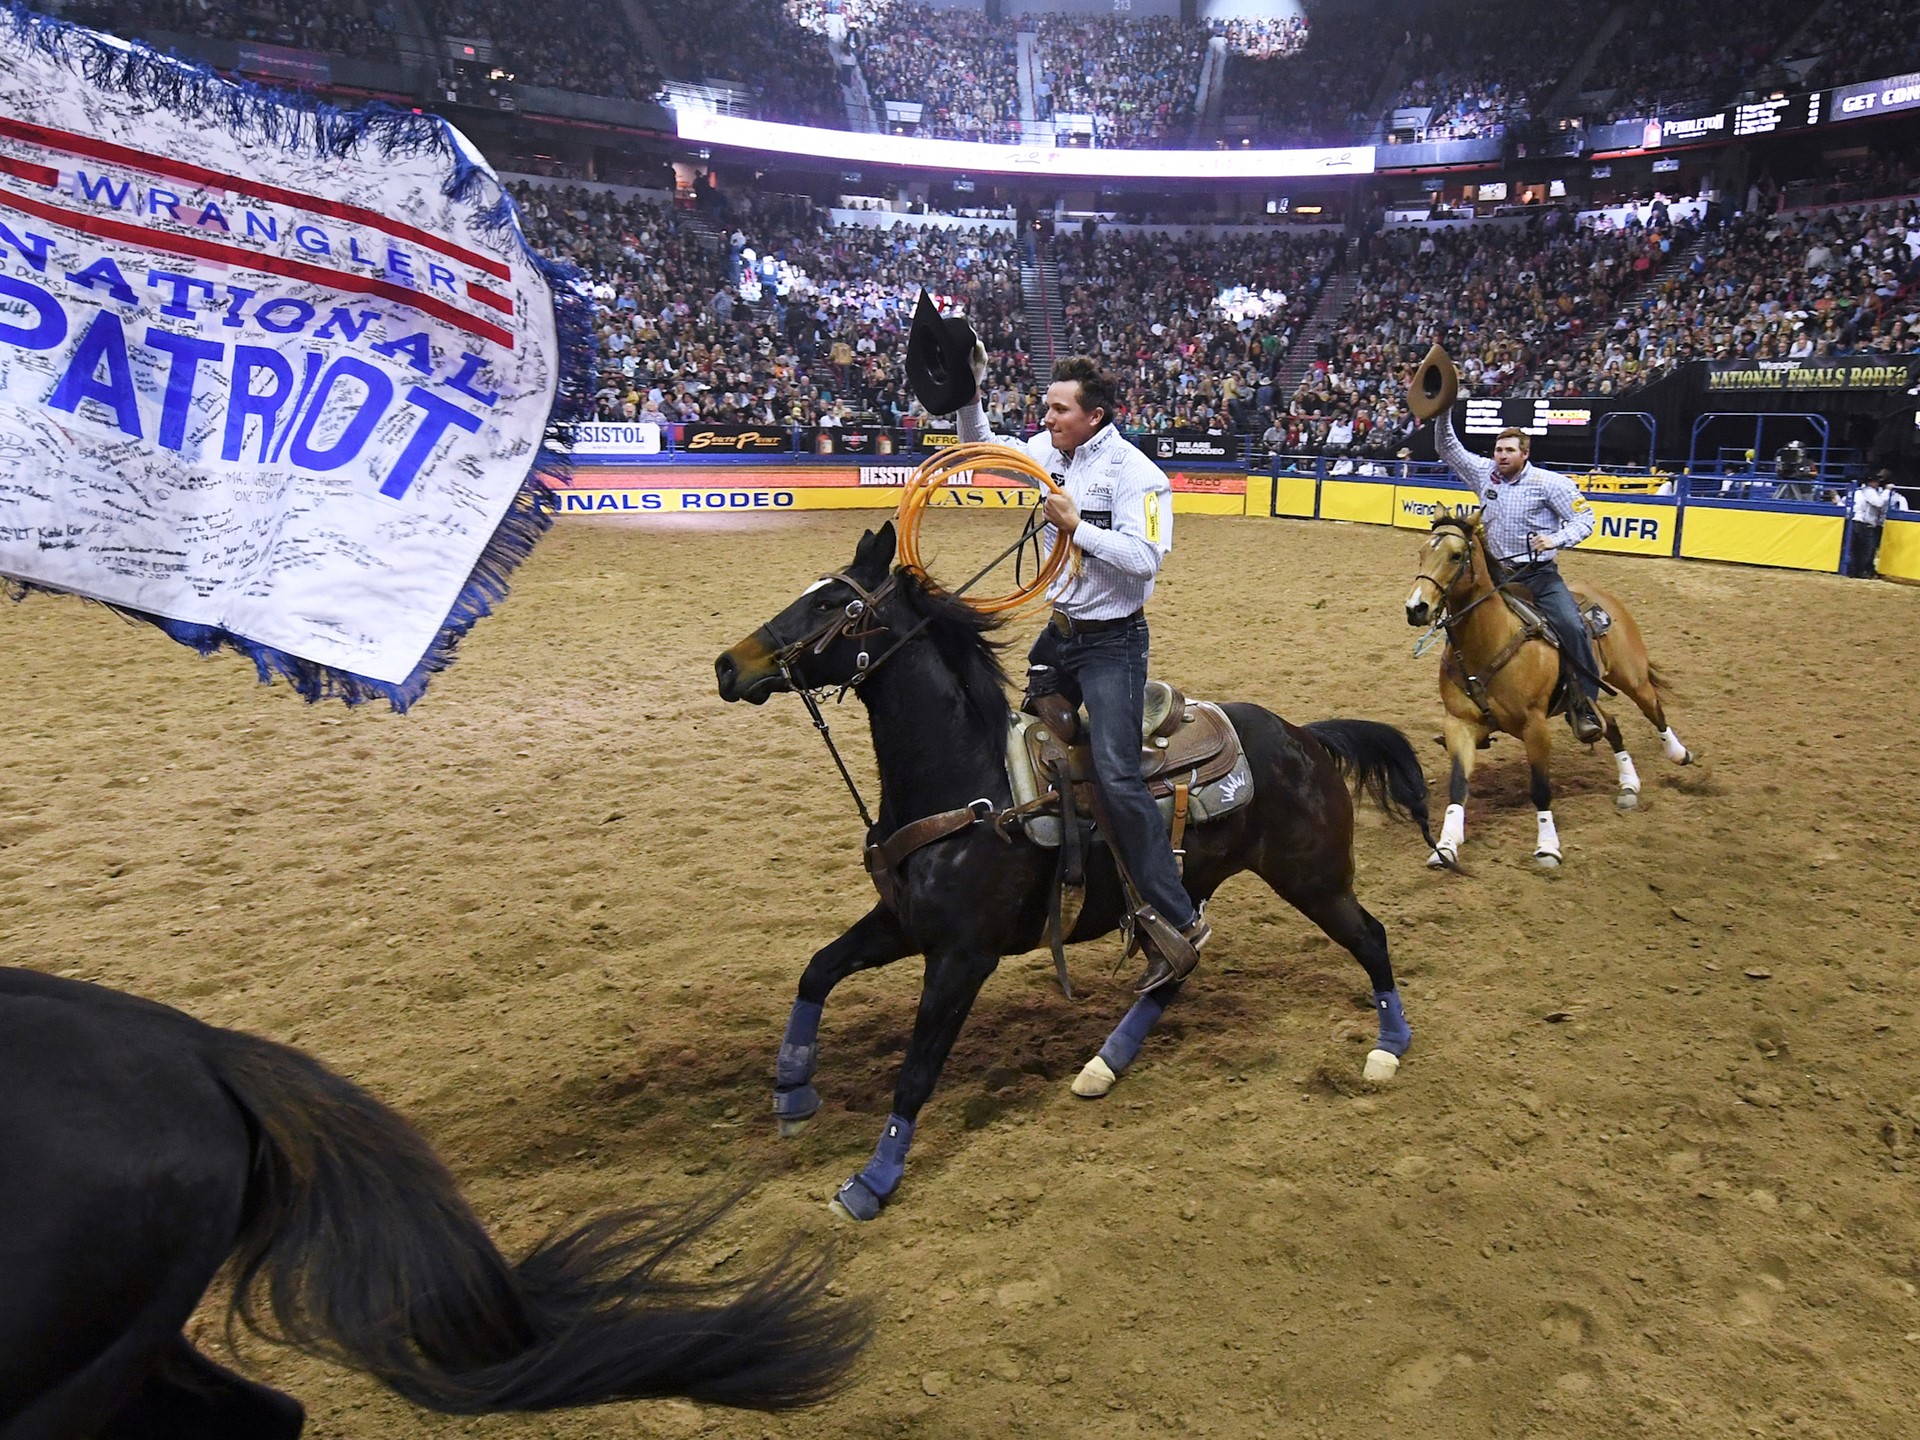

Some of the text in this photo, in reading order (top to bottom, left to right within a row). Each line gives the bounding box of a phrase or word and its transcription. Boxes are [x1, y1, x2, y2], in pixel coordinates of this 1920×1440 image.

[1113, 0, 1131, 10] 213
[1842, 93, 1877, 113] GET
[1663, 114, 1725, 136] PENDLETON
[77, 171, 457, 294] WRANGLER
[0, 221, 498, 407] NATIONAL
[1709, 366, 1908, 389] NATIONAL FINALS RODEO
[573, 426, 645, 443] ESISTOL
[554, 492, 794, 511] INALS RODEO
[926, 490, 984, 506] LAS
[1601, 516, 1659, 540] NFR
